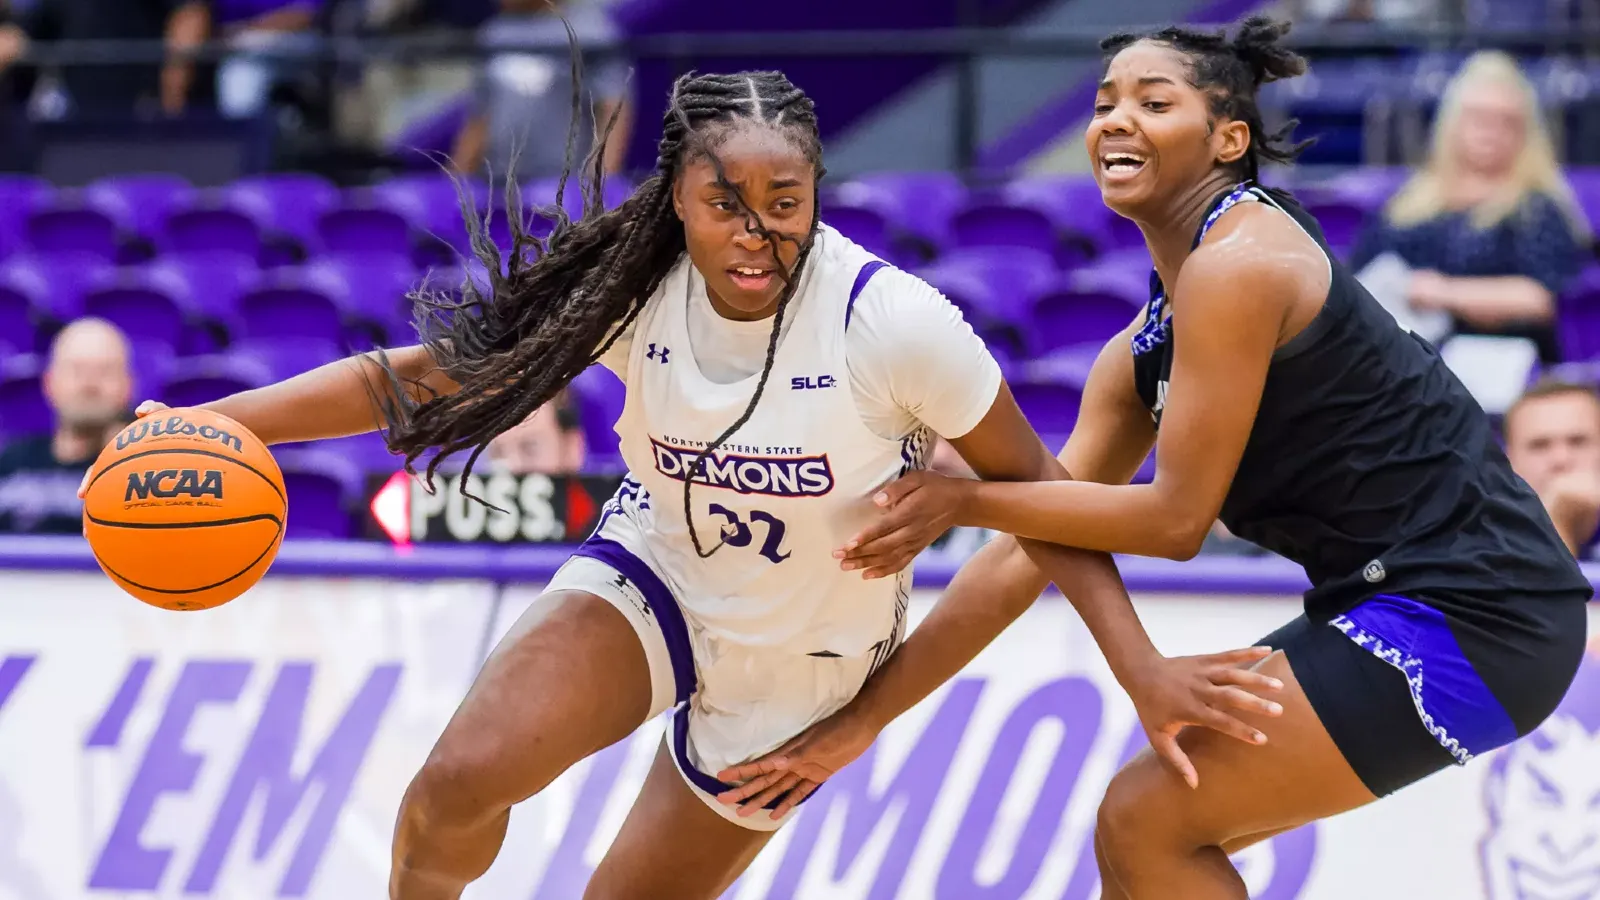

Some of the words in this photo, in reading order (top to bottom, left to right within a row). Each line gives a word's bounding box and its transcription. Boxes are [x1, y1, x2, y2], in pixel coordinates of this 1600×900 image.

[791, 375, 831, 390] SLC
[116, 416, 243, 453] Wilson
[663, 434, 759, 454] NORTHWSTERN
[766, 446, 802, 455] STATE
[124, 469, 224, 501] NCAA
[654, 443, 830, 493] DEMONS
[410, 472, 565, 542] POSS.
[709, 503, 792, 564] 32
